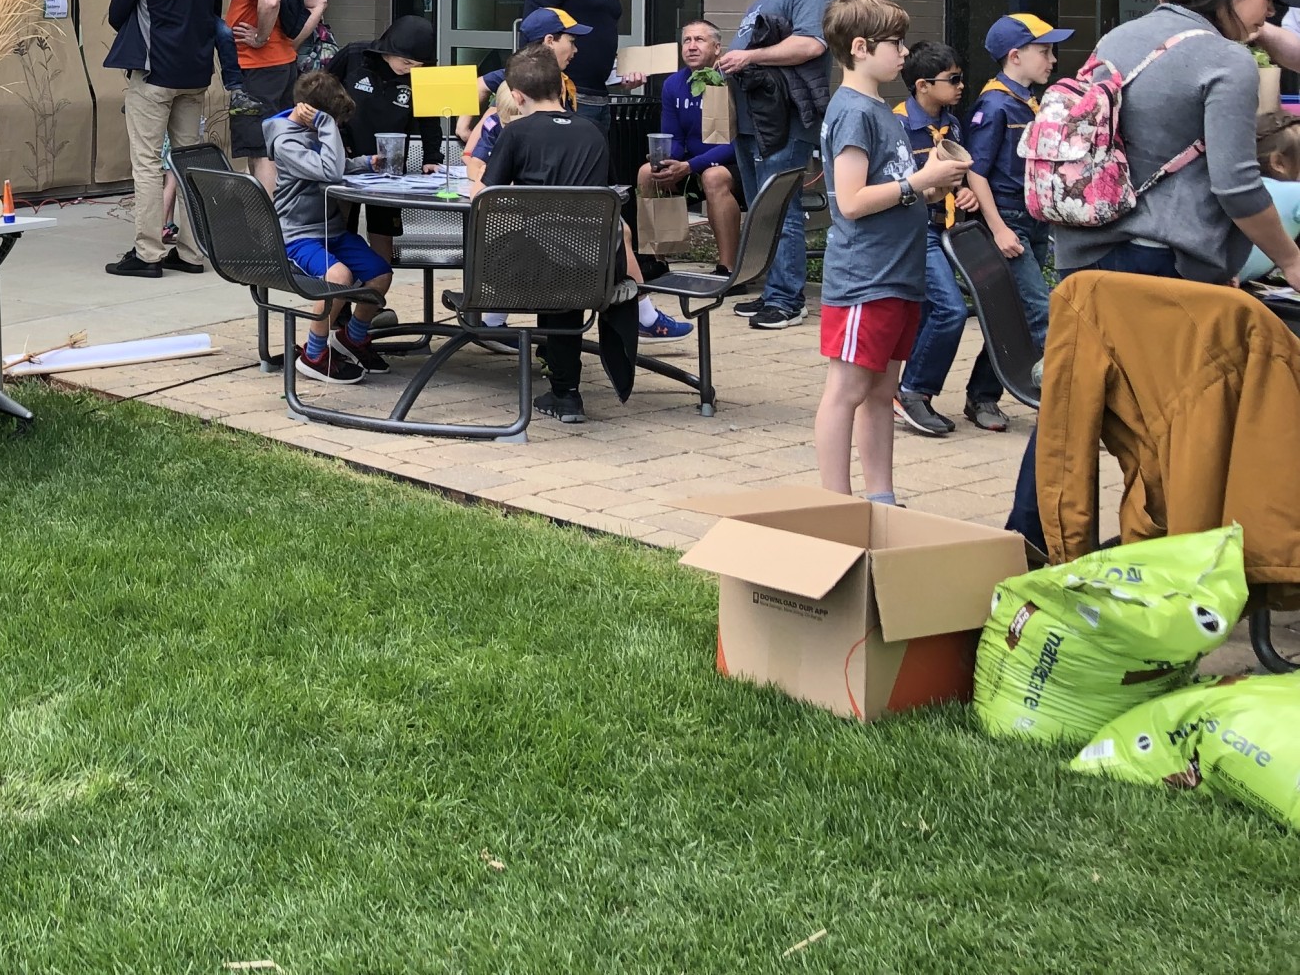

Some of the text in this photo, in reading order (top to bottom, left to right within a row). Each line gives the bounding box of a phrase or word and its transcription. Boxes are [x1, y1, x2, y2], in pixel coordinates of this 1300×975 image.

[760, 593, 829, 617] DOWNLOAD OUR APP
[1221, 728, 1272, 768] care
